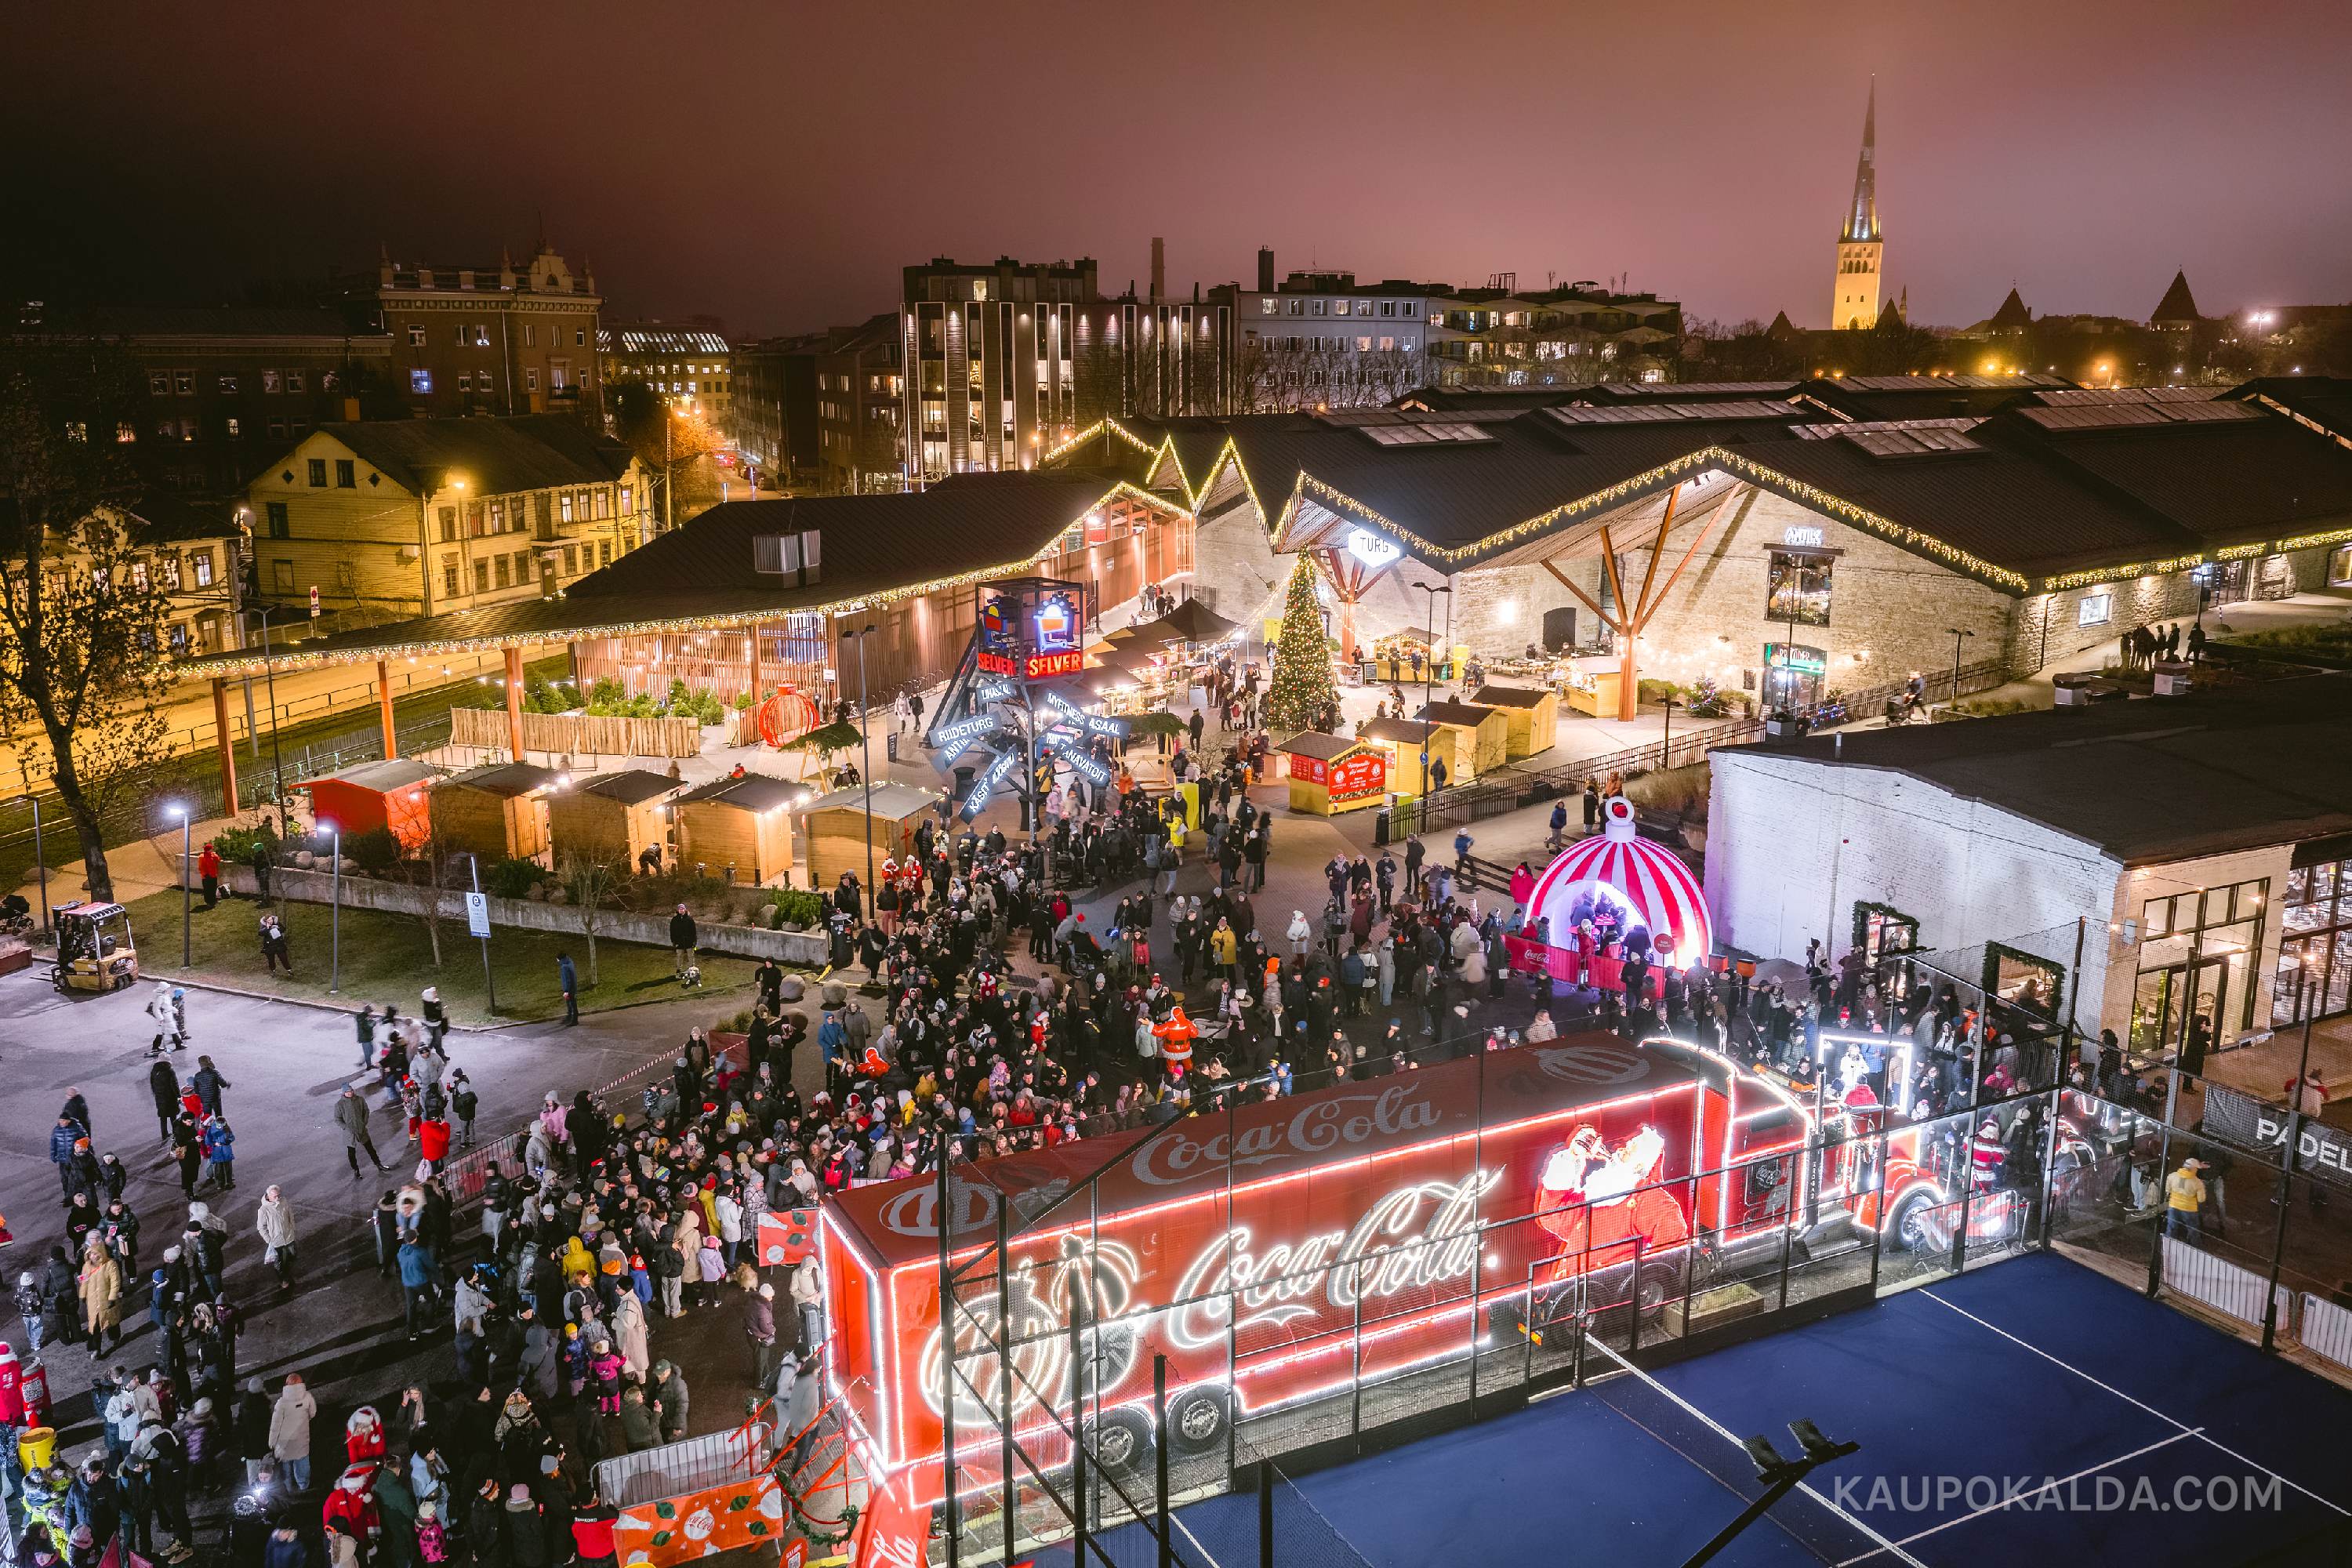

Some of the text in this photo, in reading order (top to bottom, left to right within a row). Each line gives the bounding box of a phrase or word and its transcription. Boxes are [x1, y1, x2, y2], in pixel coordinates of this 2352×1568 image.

[1360, 537, 1388, 553] TURG
[978, 652, 1016, 676] SELVER
[1029, 653, 1081, 677] SELVER
[1047, 692, 1086, 725] MYFITNESS
[938, 717, 993, 742] RIIDETURG
[1088, 717, 1121, 735] ASAAL
[944, 739, 971, 760] ANT
[969, 777, 990, 812] KÄSIT
[1131, 1082, 1443, 1186] Coca-Cola
[1167, 1163, 1507, 1349] Coca-Cola
